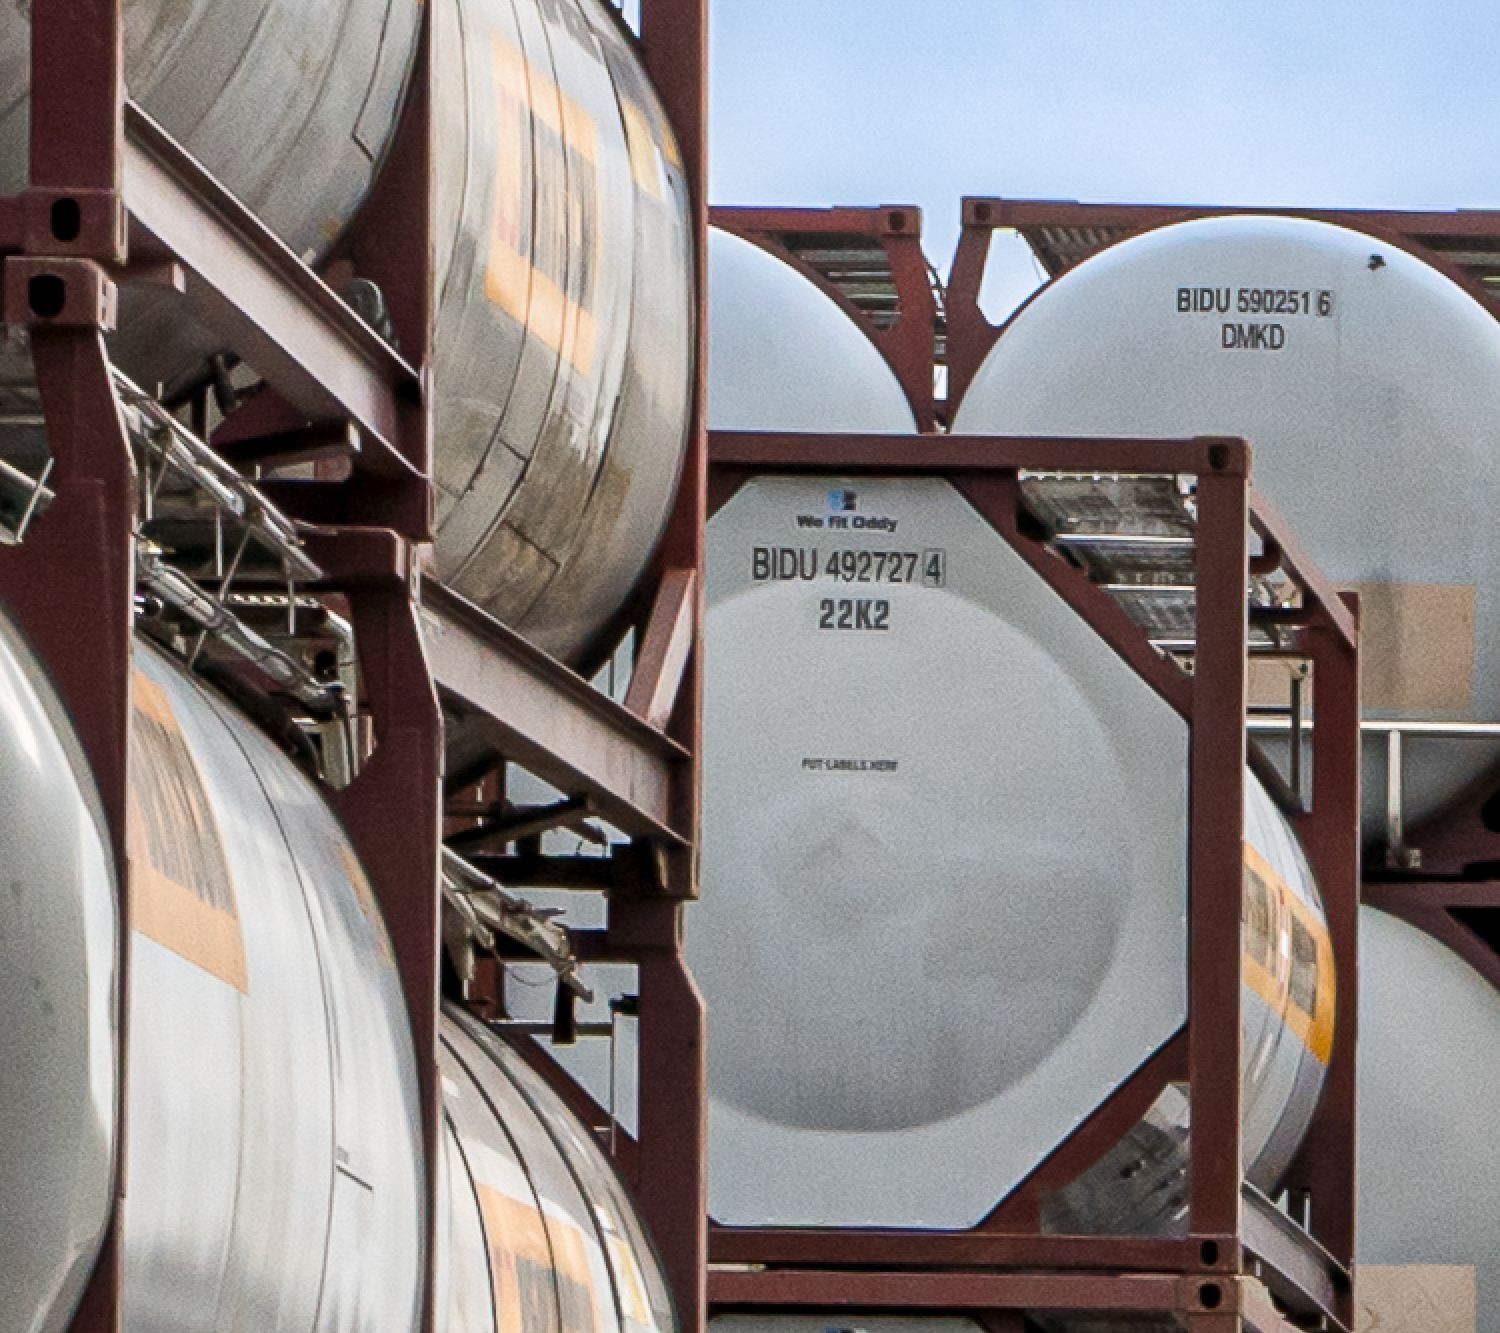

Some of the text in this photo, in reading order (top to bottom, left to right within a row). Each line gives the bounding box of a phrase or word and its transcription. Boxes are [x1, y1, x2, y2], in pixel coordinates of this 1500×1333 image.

[1177, 288, 1231, 313] BIDU
[1238, 288, 1310, 315] 590251
[1221, 323, 1285, 350] DMKD
[752, 547, 943, 586] BIDU 492727 4
[819, 598, 889, 630] 22K2
